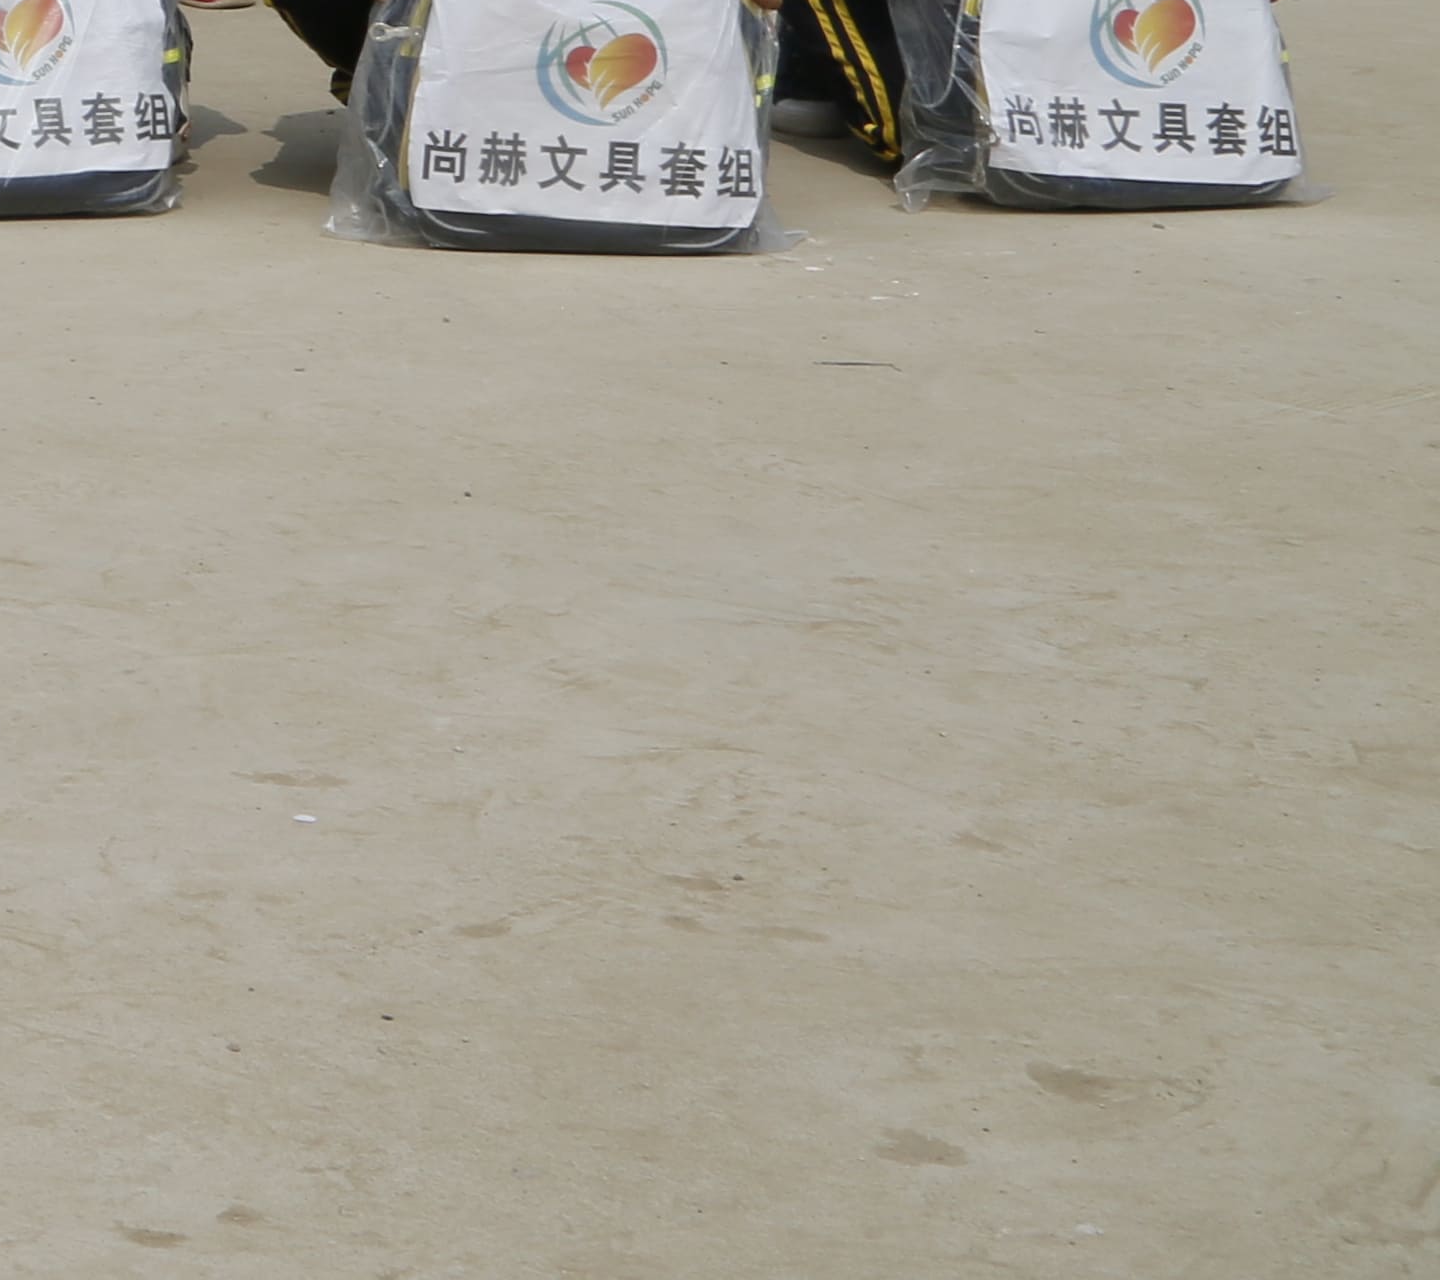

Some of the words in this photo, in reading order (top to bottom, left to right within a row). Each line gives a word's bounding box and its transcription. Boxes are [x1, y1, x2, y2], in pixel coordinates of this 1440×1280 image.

[1004, 95, 1298, 157] 尚赫文具套组
[421, 129, 758, 199] 尚赫文具套组
